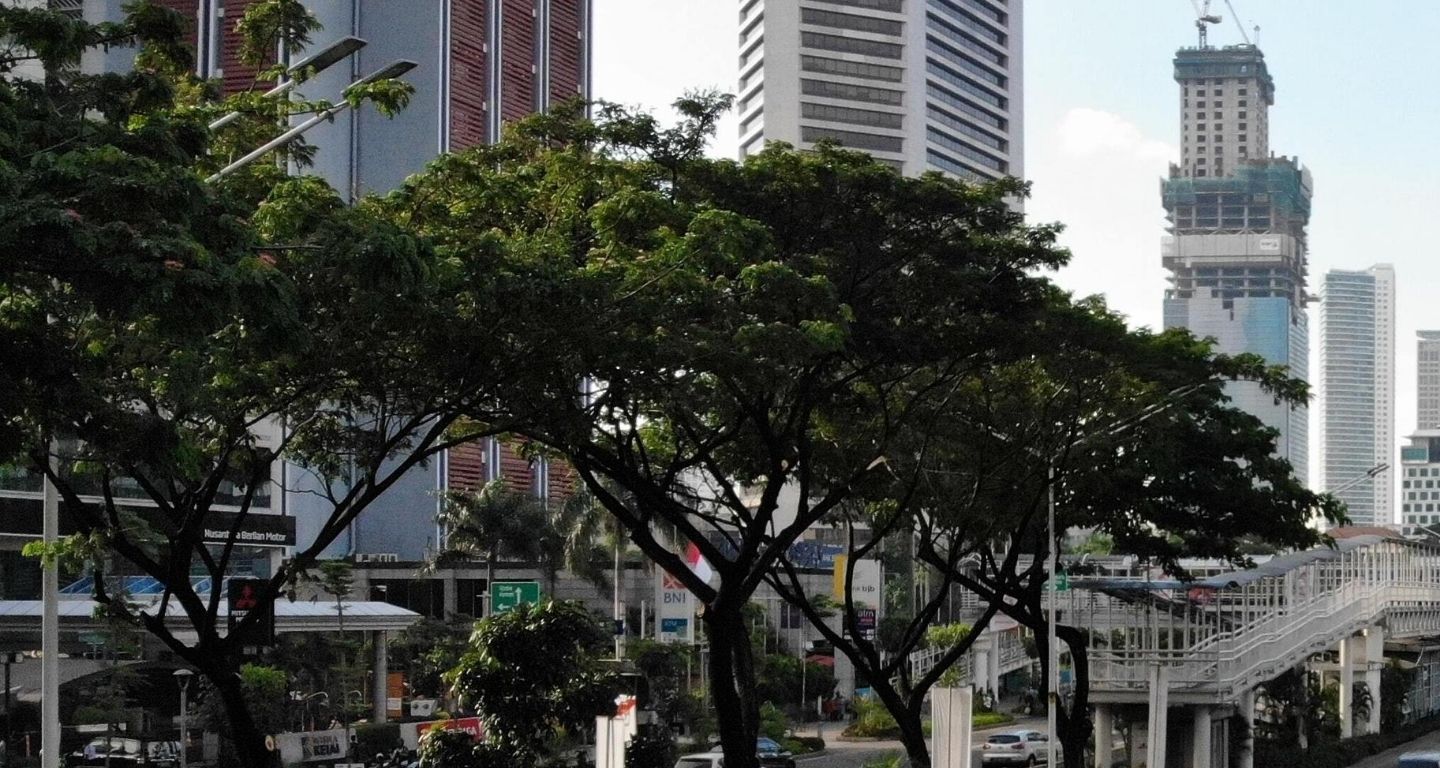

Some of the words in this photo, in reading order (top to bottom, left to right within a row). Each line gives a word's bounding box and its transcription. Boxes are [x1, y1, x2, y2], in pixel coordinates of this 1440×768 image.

[204, 528, 241, 539] Nusanta
[241, 530, 265, 540] Berlian
[265, 532, 287, 541] Motor
[663, 592, 687, 604] BNI
